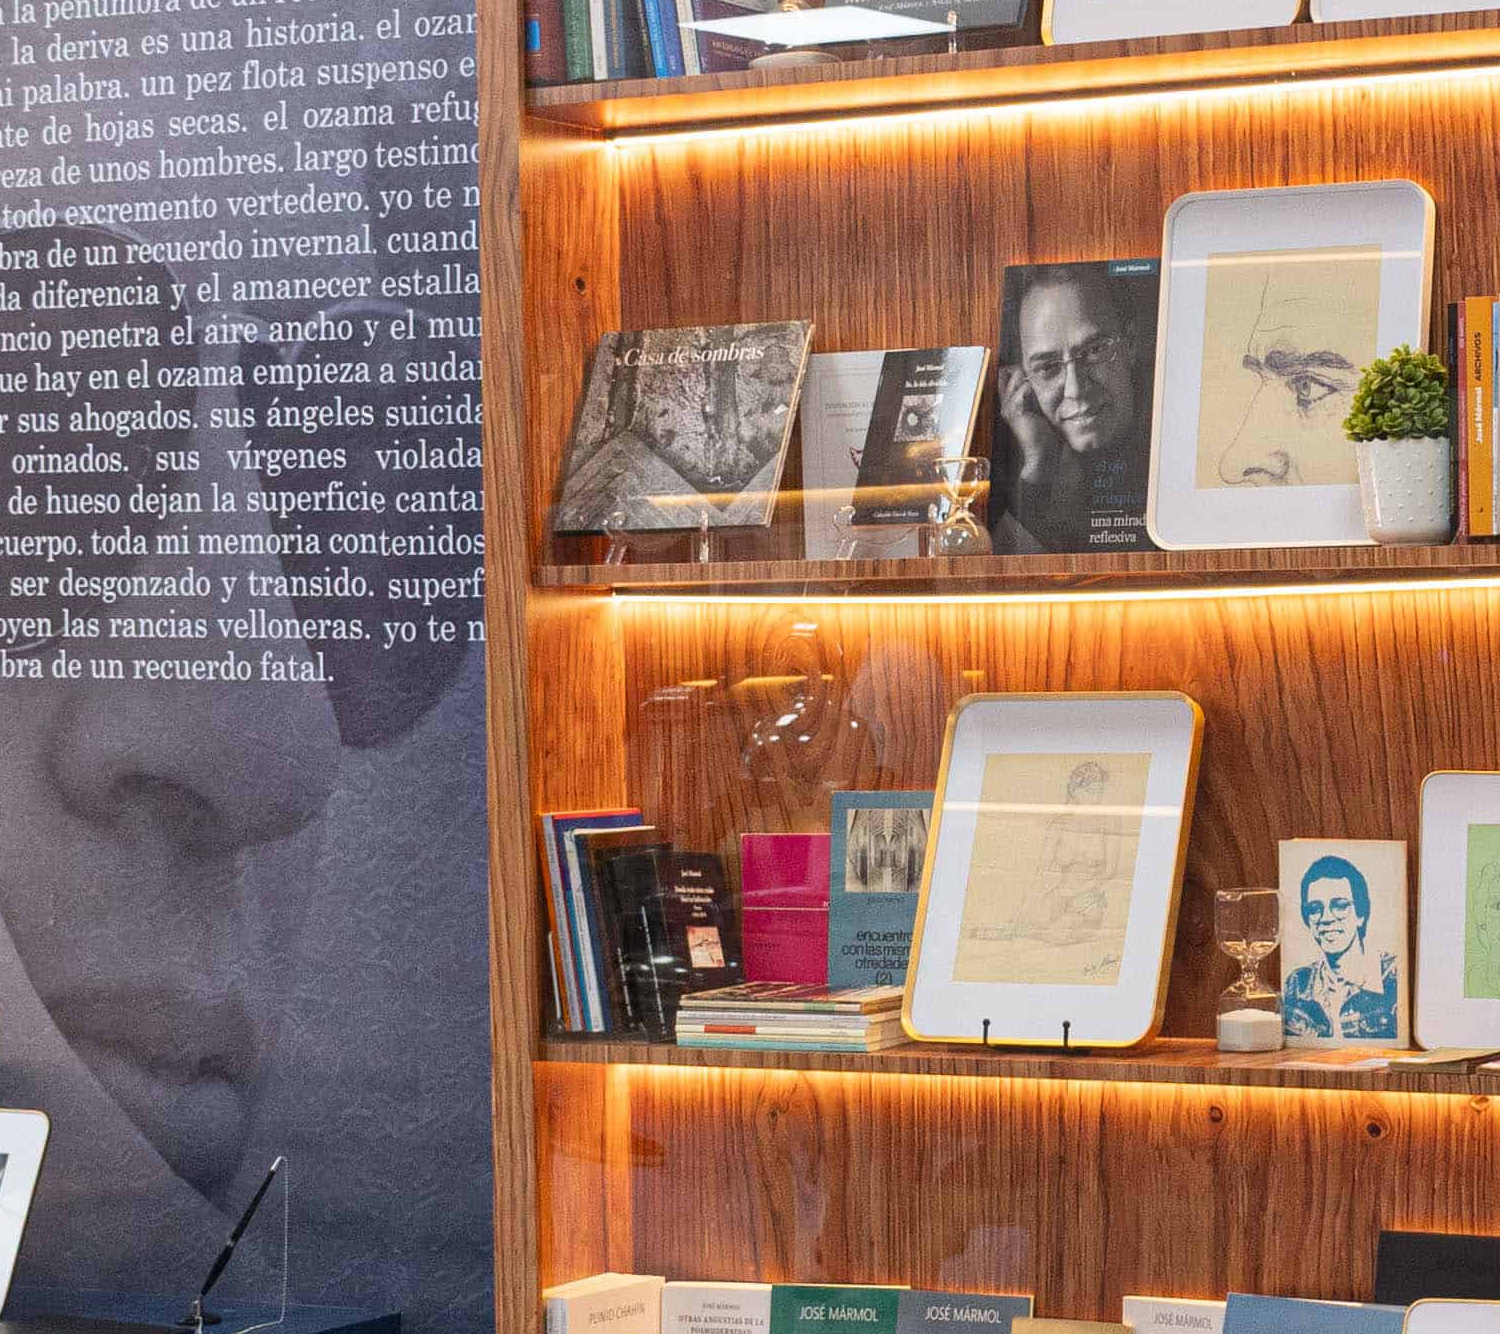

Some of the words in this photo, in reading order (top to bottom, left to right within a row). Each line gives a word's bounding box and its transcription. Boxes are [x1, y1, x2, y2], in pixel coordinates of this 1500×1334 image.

[624, 347, 665, 367] Casa
[667, 346, 689, 365] de
[691, 343, 765, 364] sombras
[1474, 331, 1482, 382] ARCHIVOS
[1091, 517, 1112, 527] una
[1113, 512, 1147, 527] mirad
[1089, 530, 1137, 544] reflexiva
[51, 647, 82, 679] de
[89, 658, 125, 681] un
[132, 649, 252, 682] recuerdo
[259, 649, 334, 683] fatal.
[856, 956, 909, 970] otredade
[799, 1305, 828, 1320] JOSÉ
[829, 1305, 879, 1323] MÁRMOL
[925, 1305, 951, 1321] JOSÉ
[952, 1305, 1002, 1324] MÁRMOL
[1154, 1311, 1175, 1327] JOSÉ
[1175, 1312, 1215, 1330] MÁRMOL
